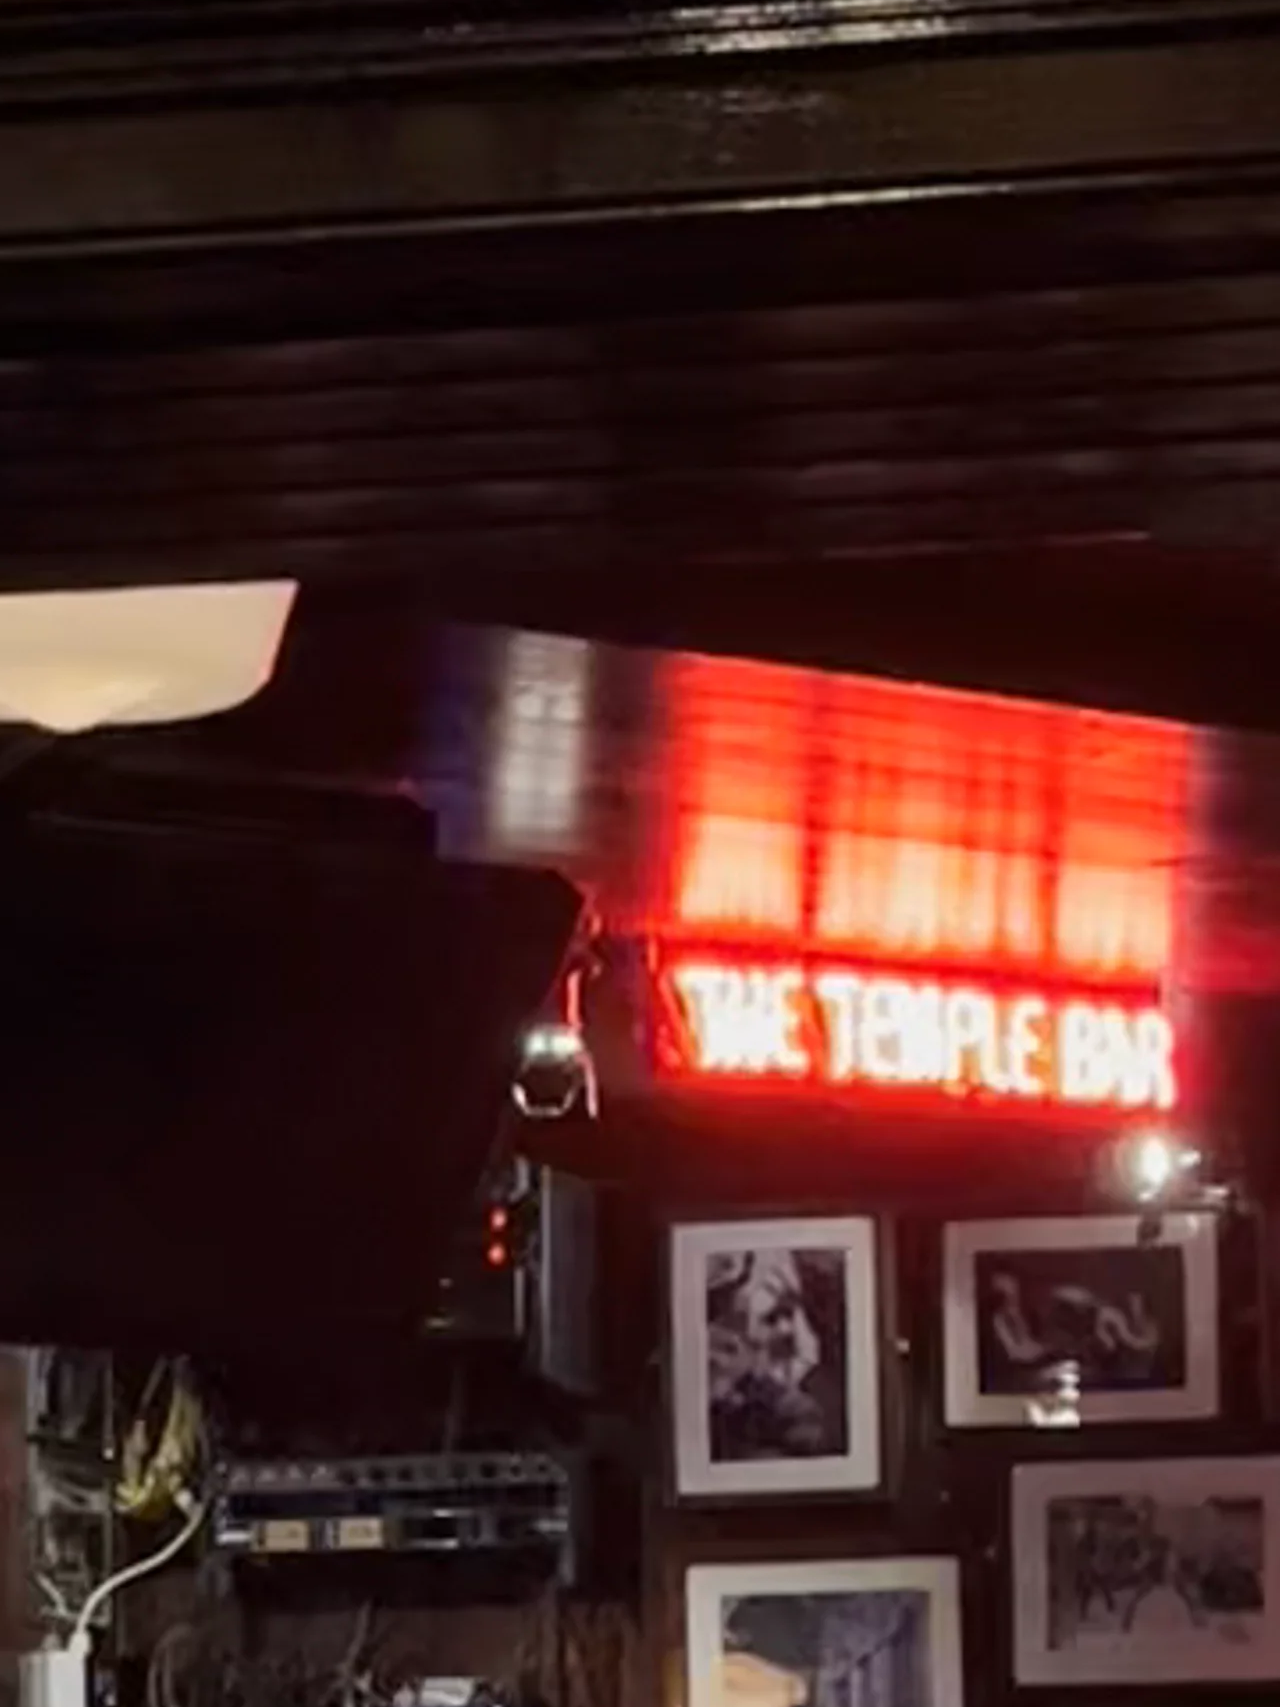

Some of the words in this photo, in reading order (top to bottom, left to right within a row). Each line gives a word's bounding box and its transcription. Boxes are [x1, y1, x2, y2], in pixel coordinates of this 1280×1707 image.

[675, 965, 808, 1075] THE
[816, 973, 1045, 1097] TEMPLE
[1056, 1000, 1177, 1110] BAR
